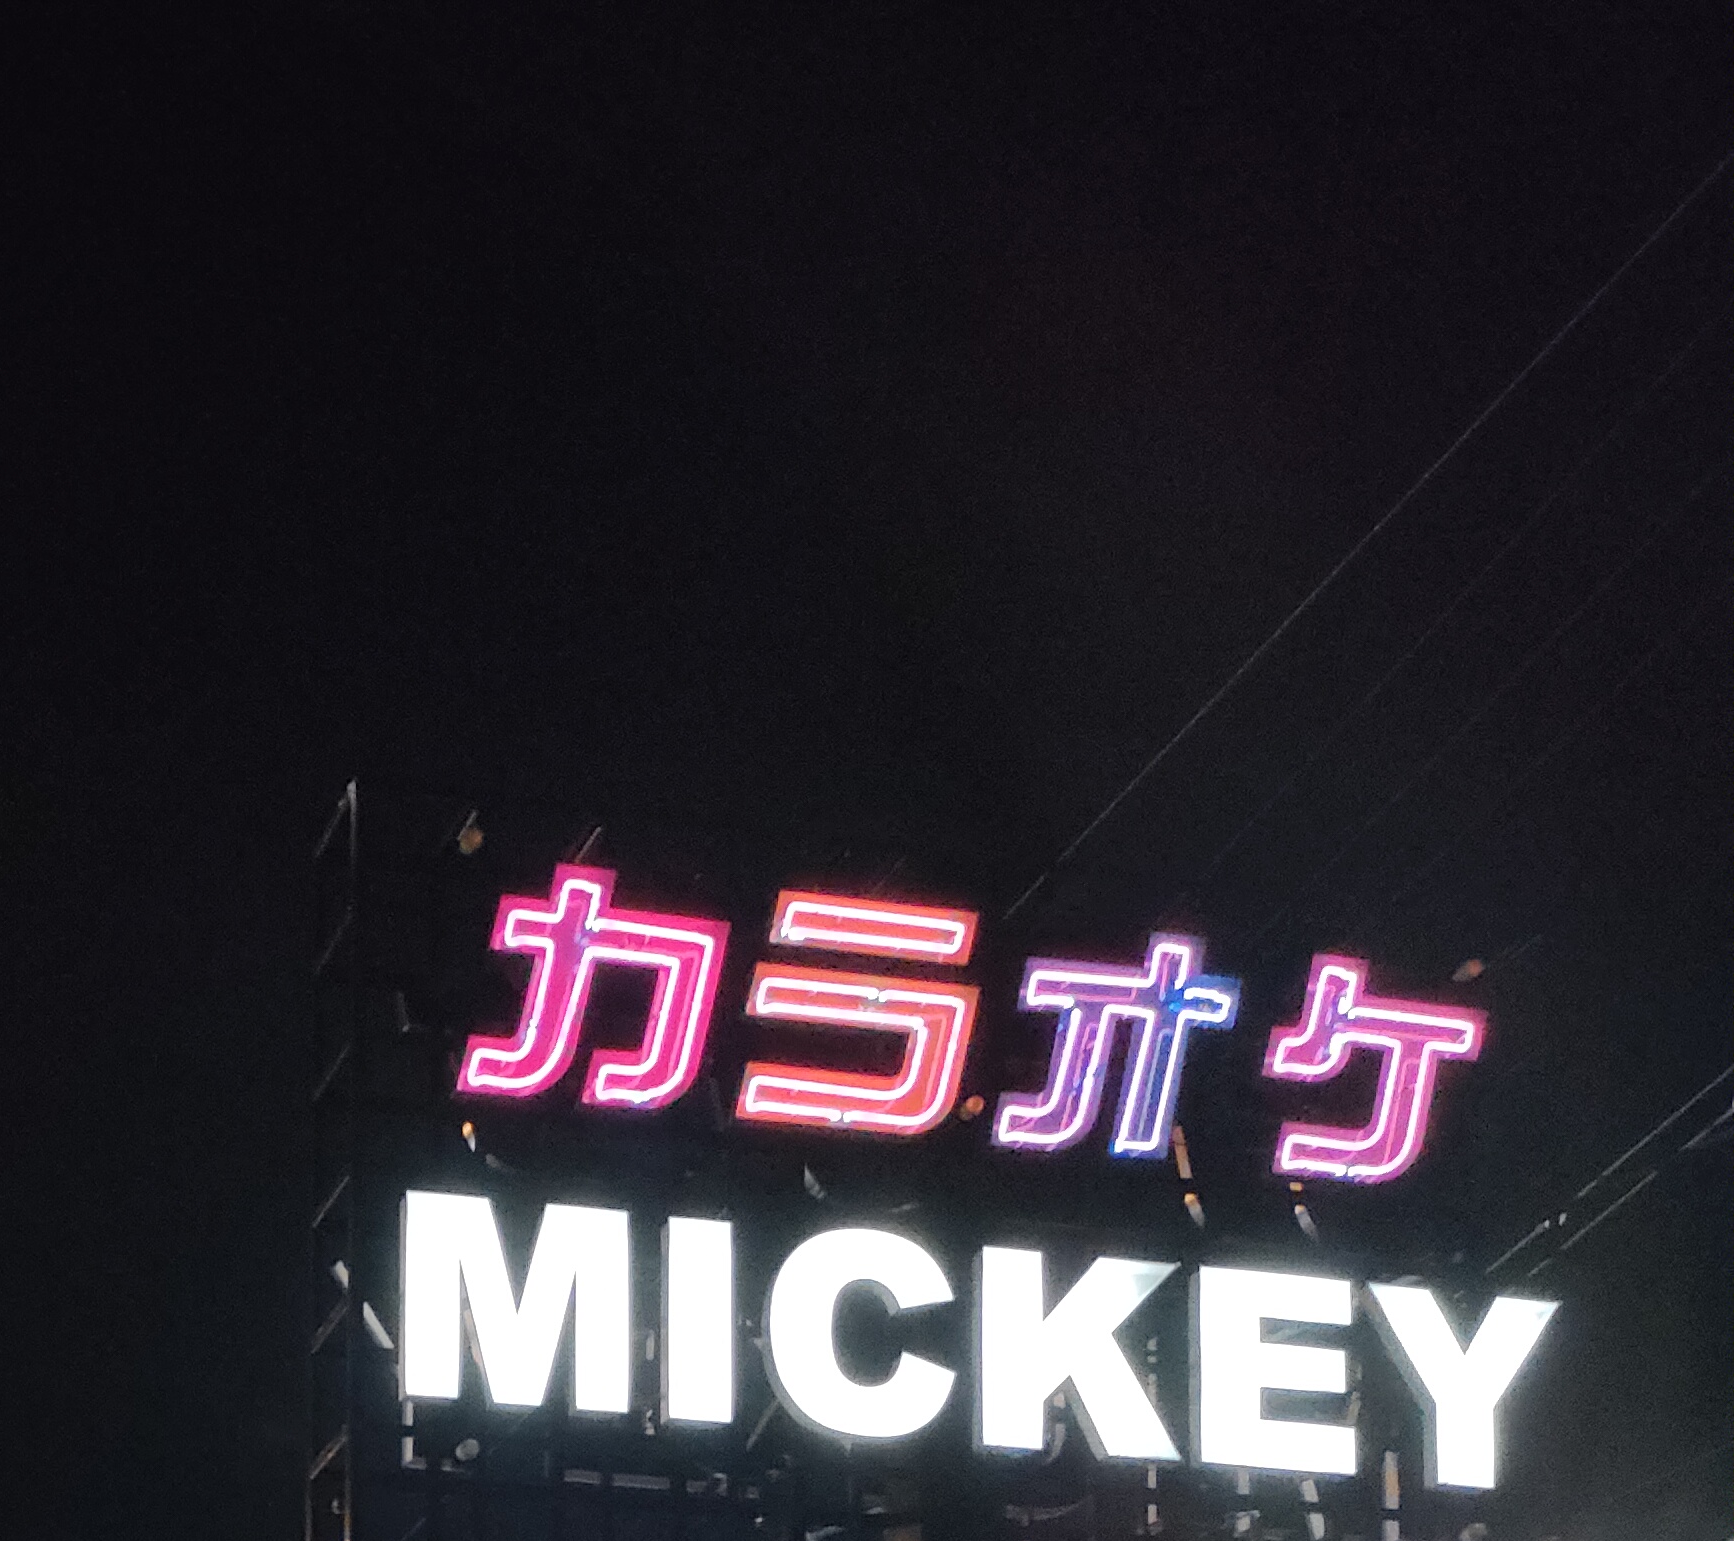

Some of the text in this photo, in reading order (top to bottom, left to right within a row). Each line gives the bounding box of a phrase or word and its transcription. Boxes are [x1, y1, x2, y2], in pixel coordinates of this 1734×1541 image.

[455, 862, 1489, 1185] カラオケ
[399, 1190, 1561, 1492] MICKEY
